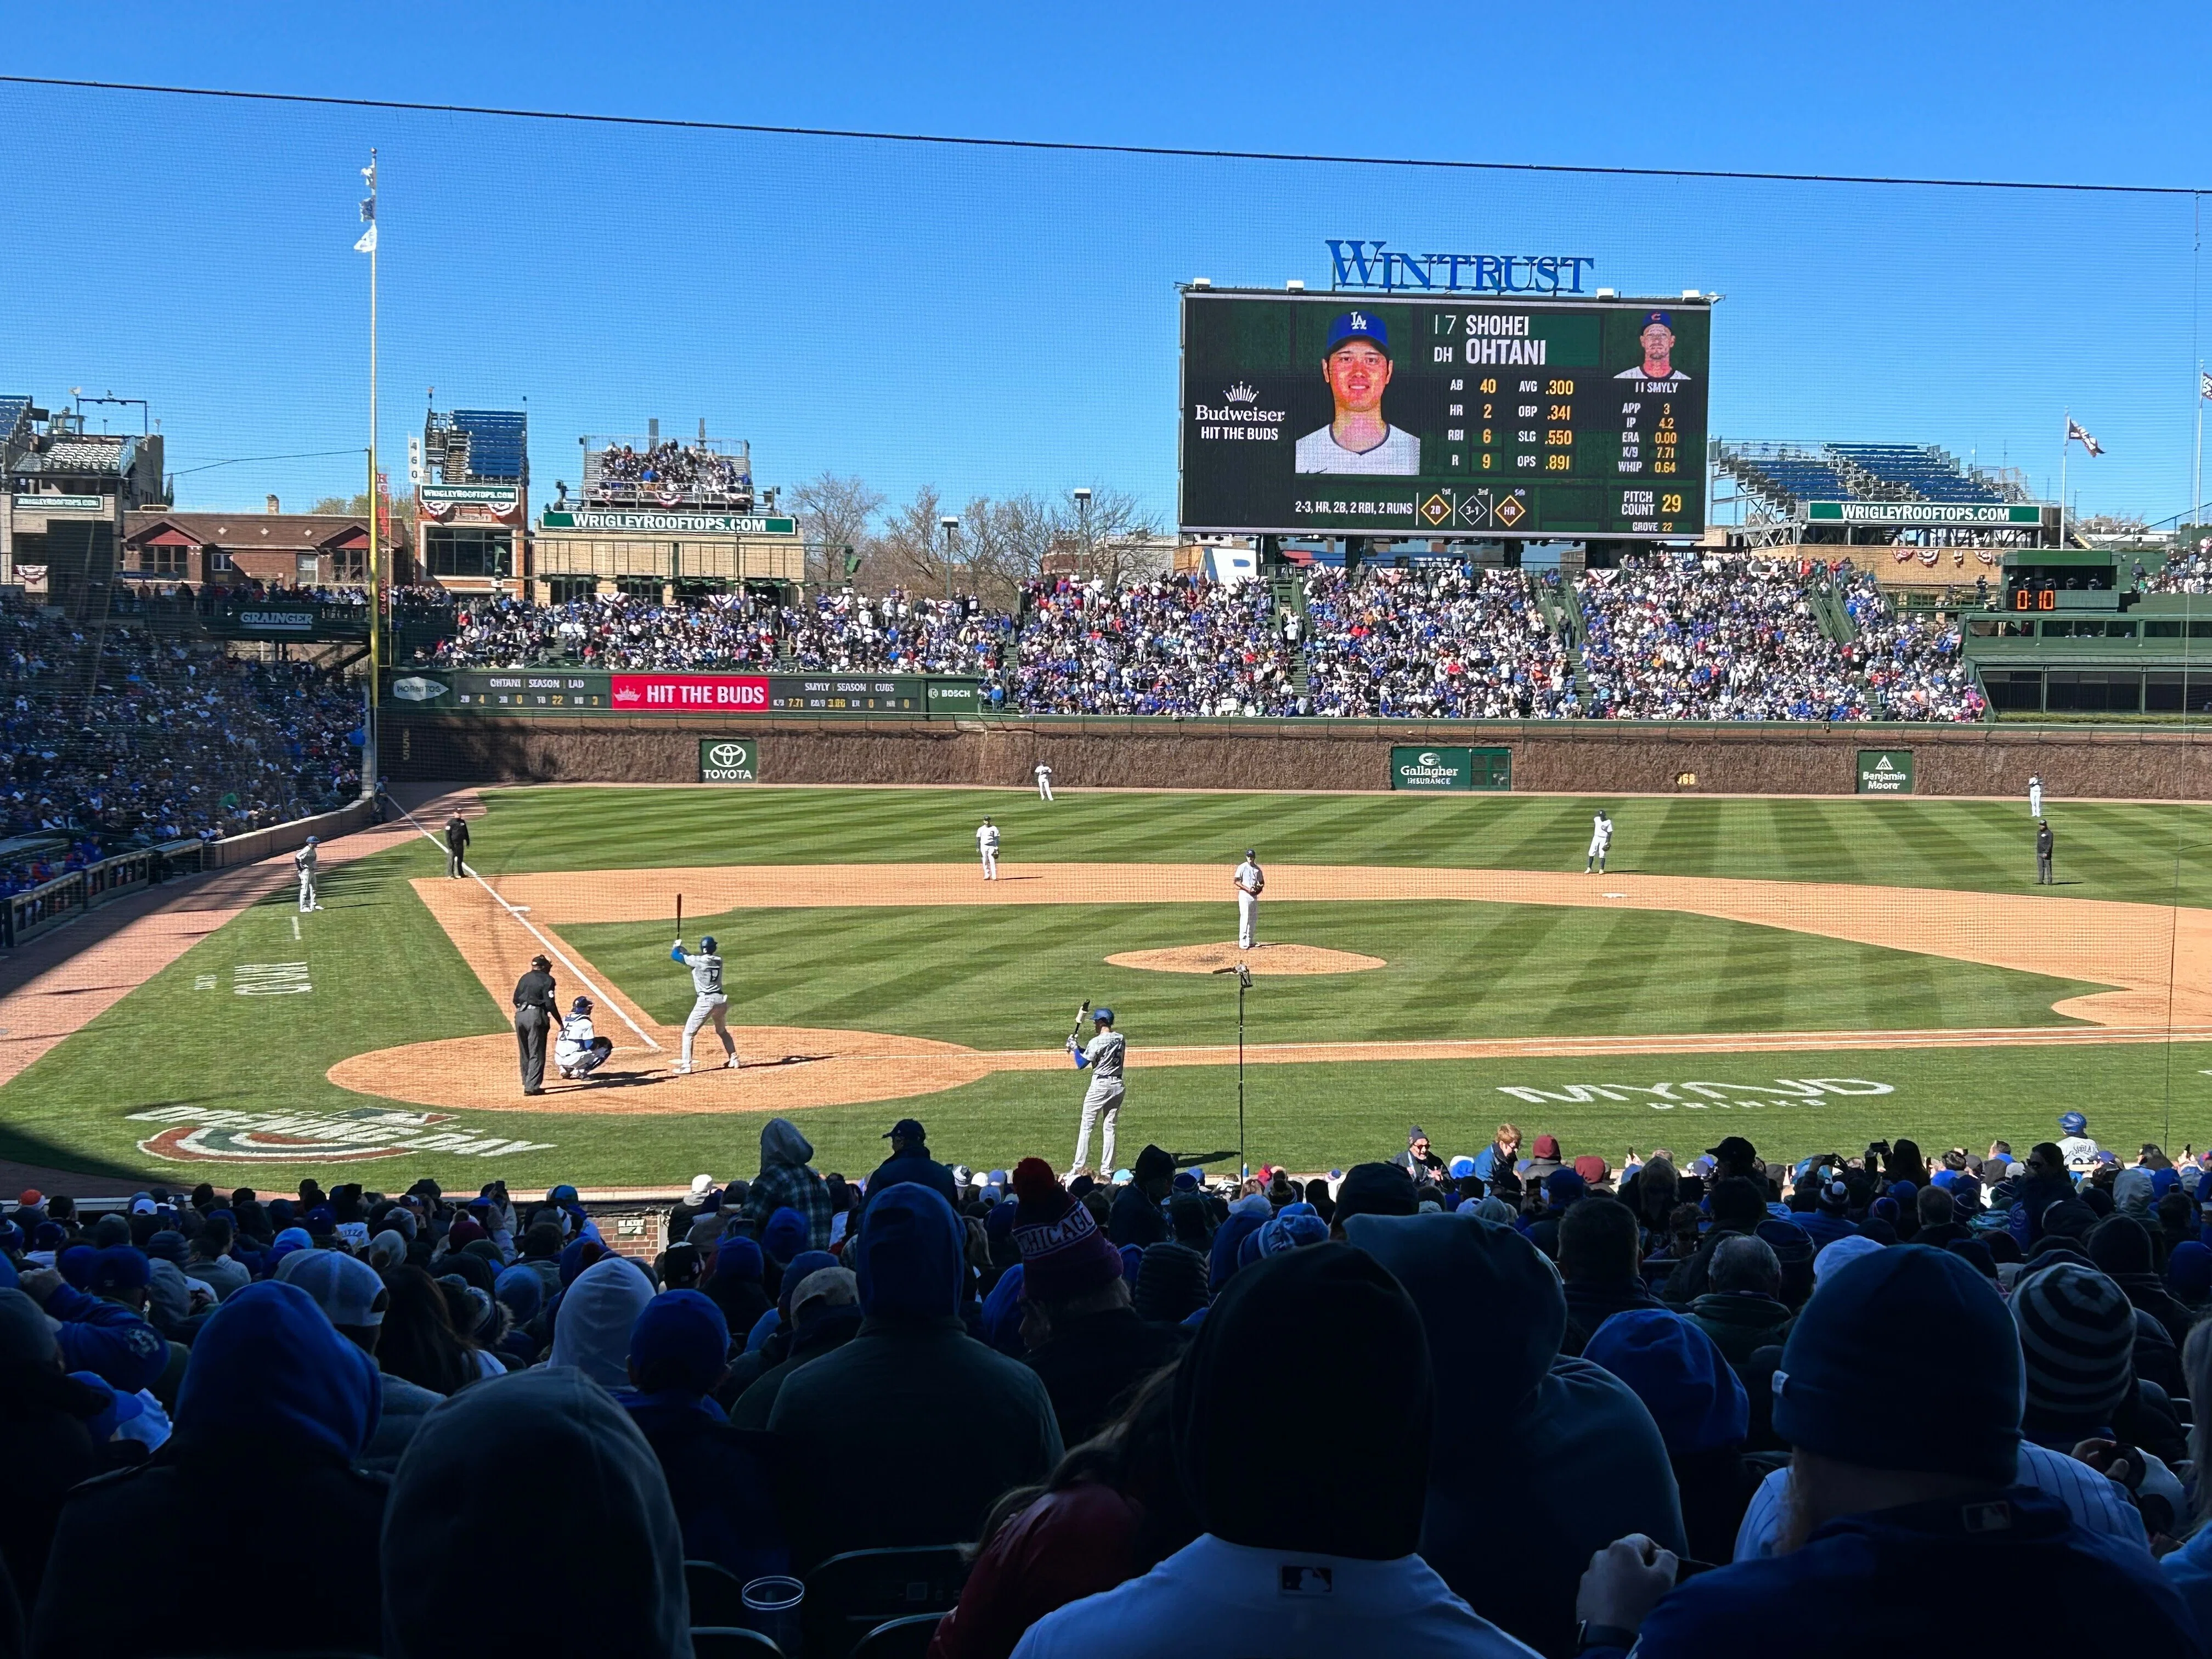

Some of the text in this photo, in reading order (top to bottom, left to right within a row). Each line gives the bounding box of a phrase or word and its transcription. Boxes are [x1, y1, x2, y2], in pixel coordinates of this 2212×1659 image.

[1325, 240, 1594, 293] WINTRUST
[1351, 312, 1367, 329] LA
[1435, 314, 1529, 336] 17 SHOHEI
[1434, 338, 1546, 366] DH OHTANI
[1450, 379, 1573, 395] AB 40 AVG .300
[1647, 382, 1678, 393] SMYLY
[1195, 404, 1285, 422] Budweiser
[1450, 404, 1570, 421] HR 2 OBP .341
[1622, 403, 1671, 415] APP 3
[1627, 417, 1674, 429] IP 4.2
[1201, 426, 1278, 441] HIT THE BUDS
[1448, 428, 1572, 445] RBI 6 SLG .550
[1622, 432, 1677, 444] ERA 0.00
[1657, 447, 1674, 459] 7.71
[1452, 454, 1570, 470] R 9 OPS .891
[1618, 461, 1676, 473] WHIP 0.64
[1295, 501, 1413, 515] 2-3, HR, 2B, 2 RBI, 2 RUNS
[1624, 490, 1681, 512] PITCH 29
[1504, 506, 1515, 516] HR
[1622, 504, 1655, 516] COUNT
[1841, 505, 2010, 521] WRIGLEYROOFTOPS.COM
[572, 514, 766, 532] WRIGLEYROOFTOPS.COM
[2017, 590, 2053, 610] 0:10
[240, 612, 313, 624] GRAINGER
[568, 680, 584, 688] LAD
[875, 684, 894, 692] CUBS
[647, 685, 764, 704] HIT THE BUDS
[703, 769, 752, 779] TOYOTA
[1400, 765, 1458, 777] Gallagher
[1863, 771, 1906, 782] Benjamin
[1868, 781, 1900, 789] Moore
[1496, 1078, 1895, 1103] MYND
[1647, 1099, 1826, 1110] DRINKS
[125, 1105, 558, 1157] OPENING DAY
